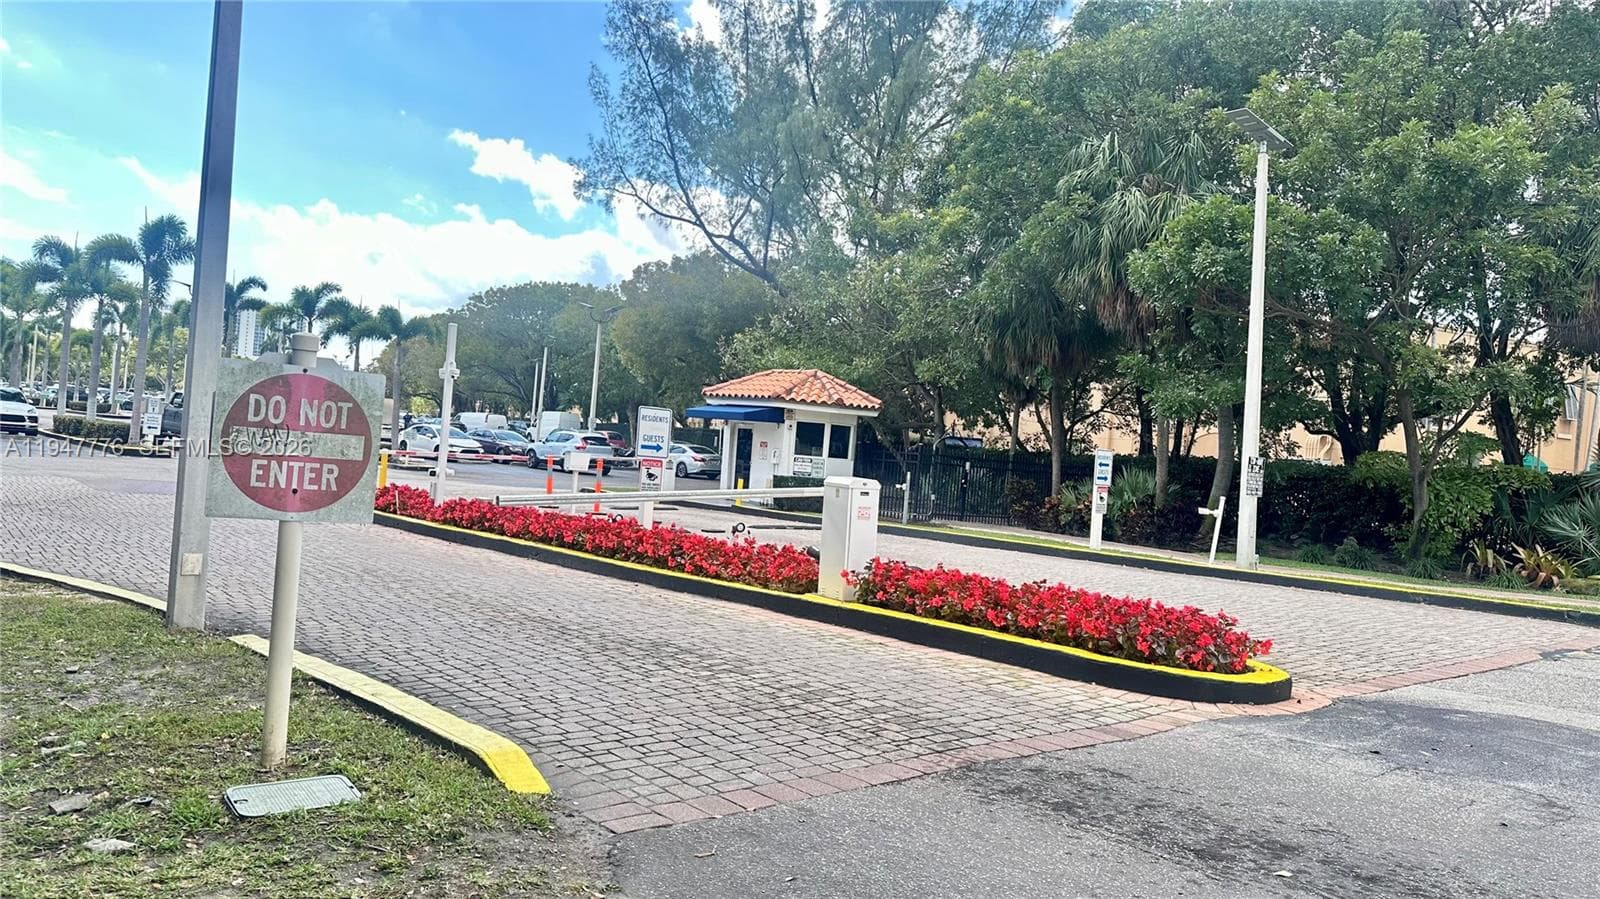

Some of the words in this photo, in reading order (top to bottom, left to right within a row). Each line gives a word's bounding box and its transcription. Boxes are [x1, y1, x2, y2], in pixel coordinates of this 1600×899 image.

[247, 393, 287, 424] DO
[300, 398, 353, 430] NOT
[641, 414, 669, 424] RESIDENTS
[642, 434, 665, 443] GUESTS
[249, 459, 340, 491] ENTER
